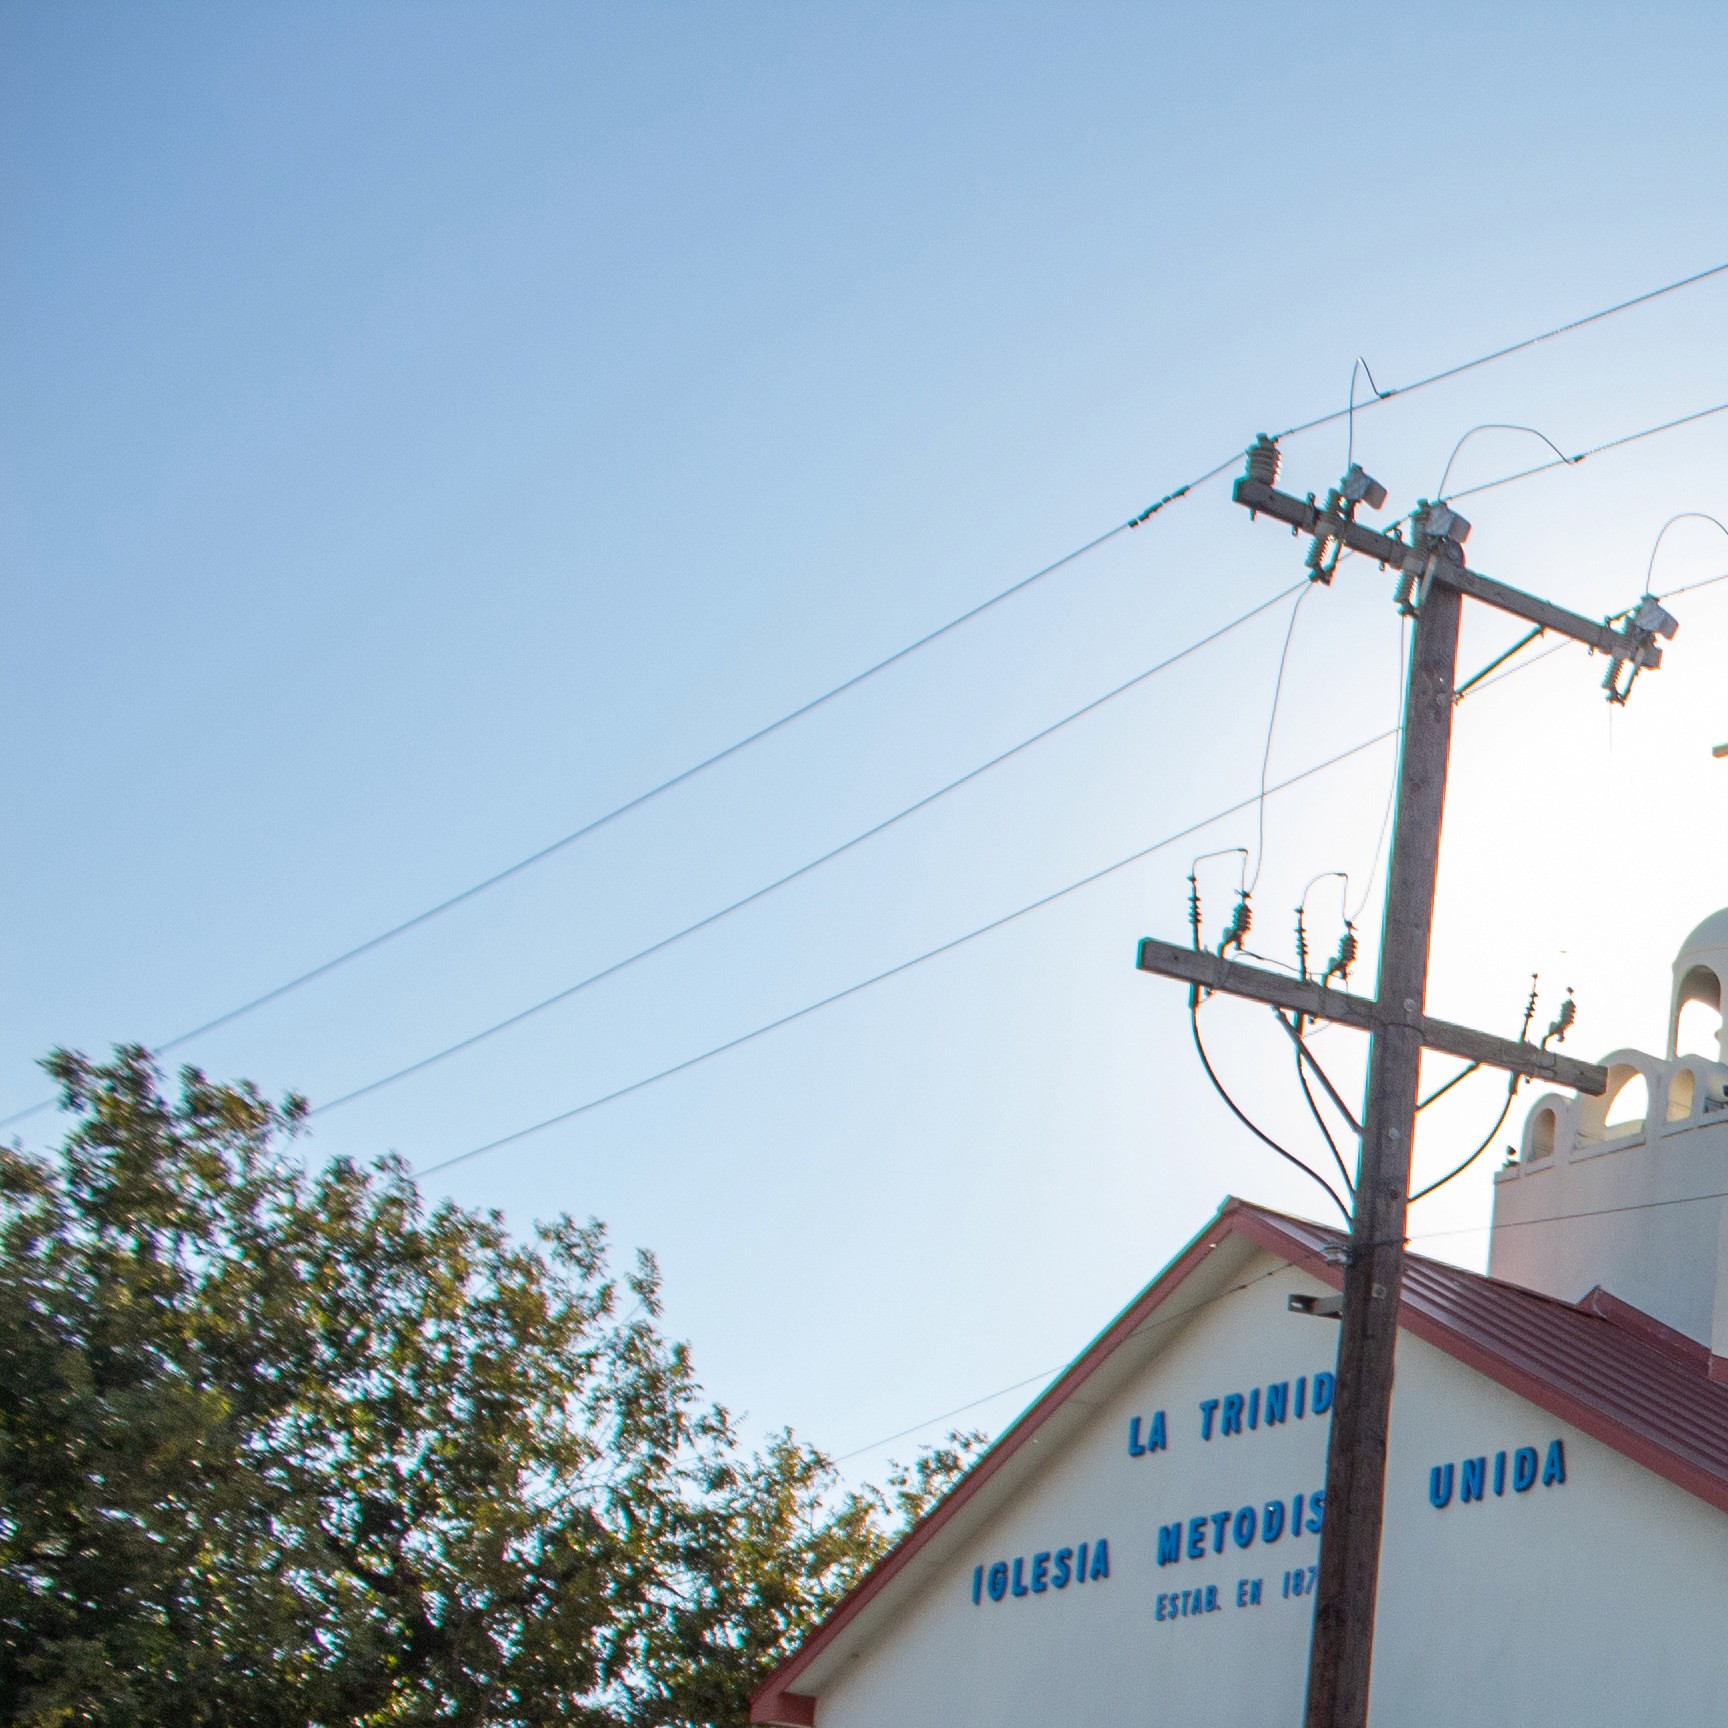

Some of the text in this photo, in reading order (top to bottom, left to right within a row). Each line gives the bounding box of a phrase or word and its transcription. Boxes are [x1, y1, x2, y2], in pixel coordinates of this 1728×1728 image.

[1127, 1371, 1336, 1457] LA TRINID
[971, 1438, 1567, 1607] IGLESIA METODIS UNIDA
[1154, 1566, 1319, 1621] ESTAB. EN 187
